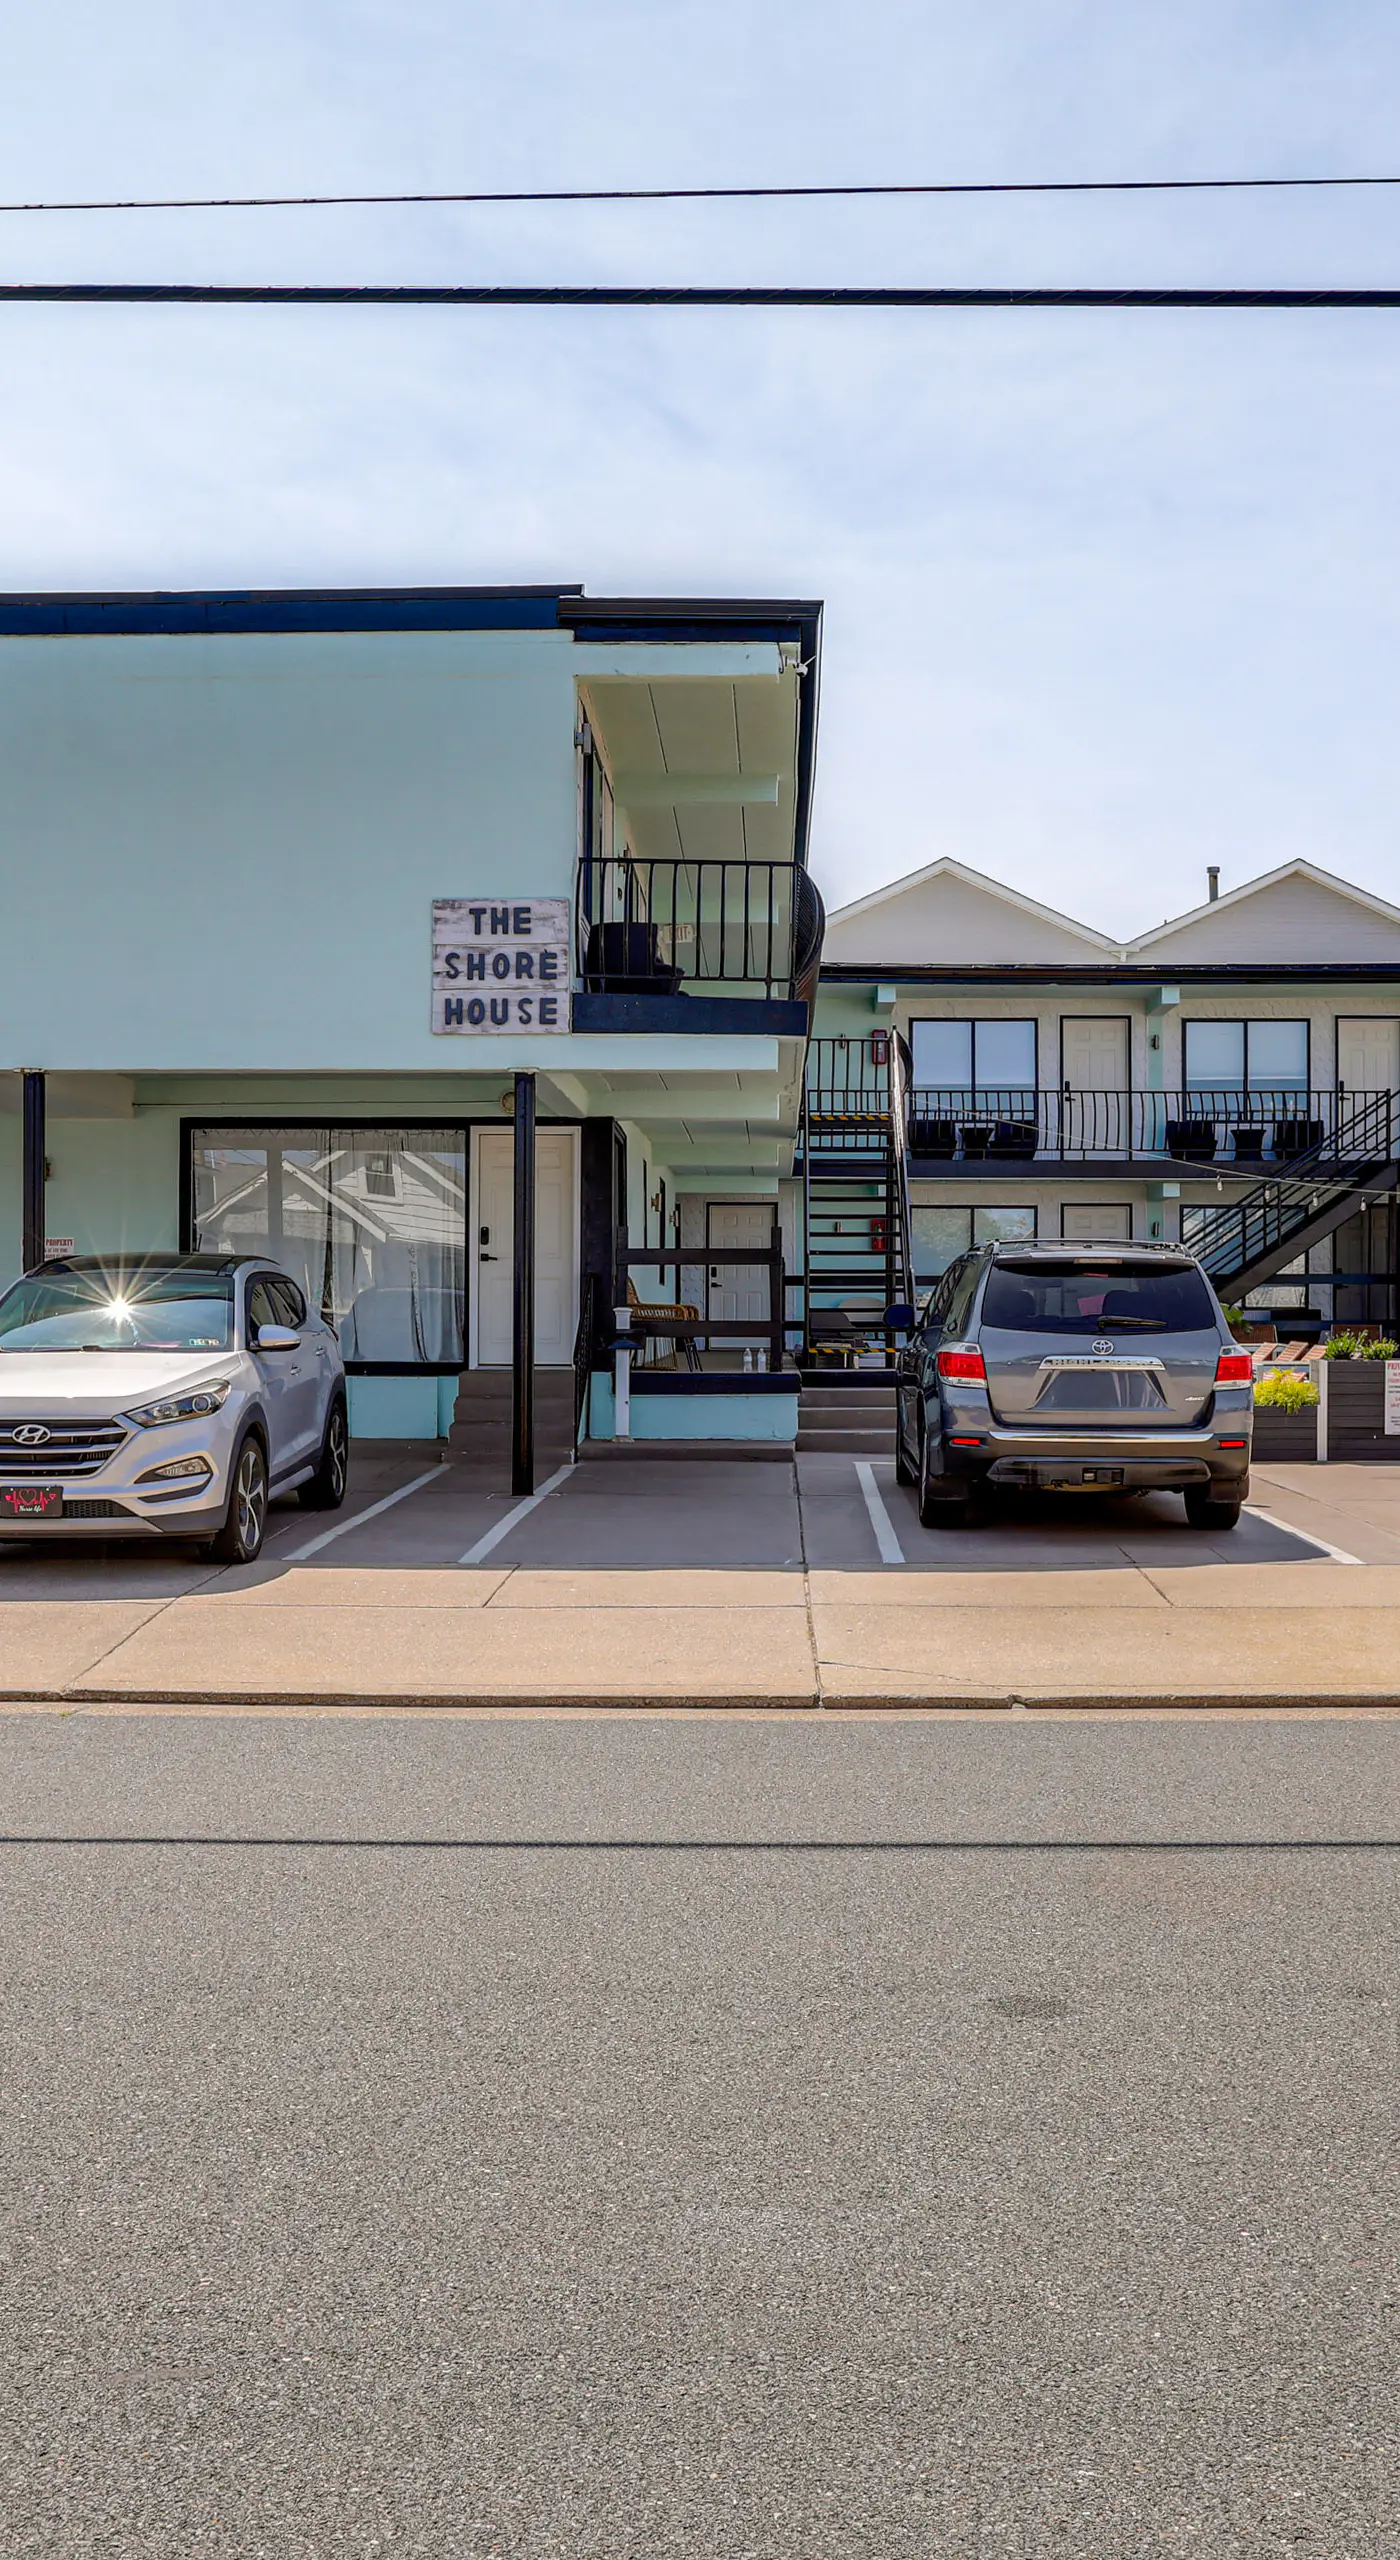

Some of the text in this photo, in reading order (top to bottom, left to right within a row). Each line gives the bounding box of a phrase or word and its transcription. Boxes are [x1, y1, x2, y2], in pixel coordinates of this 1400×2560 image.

[469, 907, 531, 935] THE
[445, 951, 558, 980] SHORE
[444, 998, 558, 1026] HOUSE
[45, 1238, 73, 1247] PROPERTY
